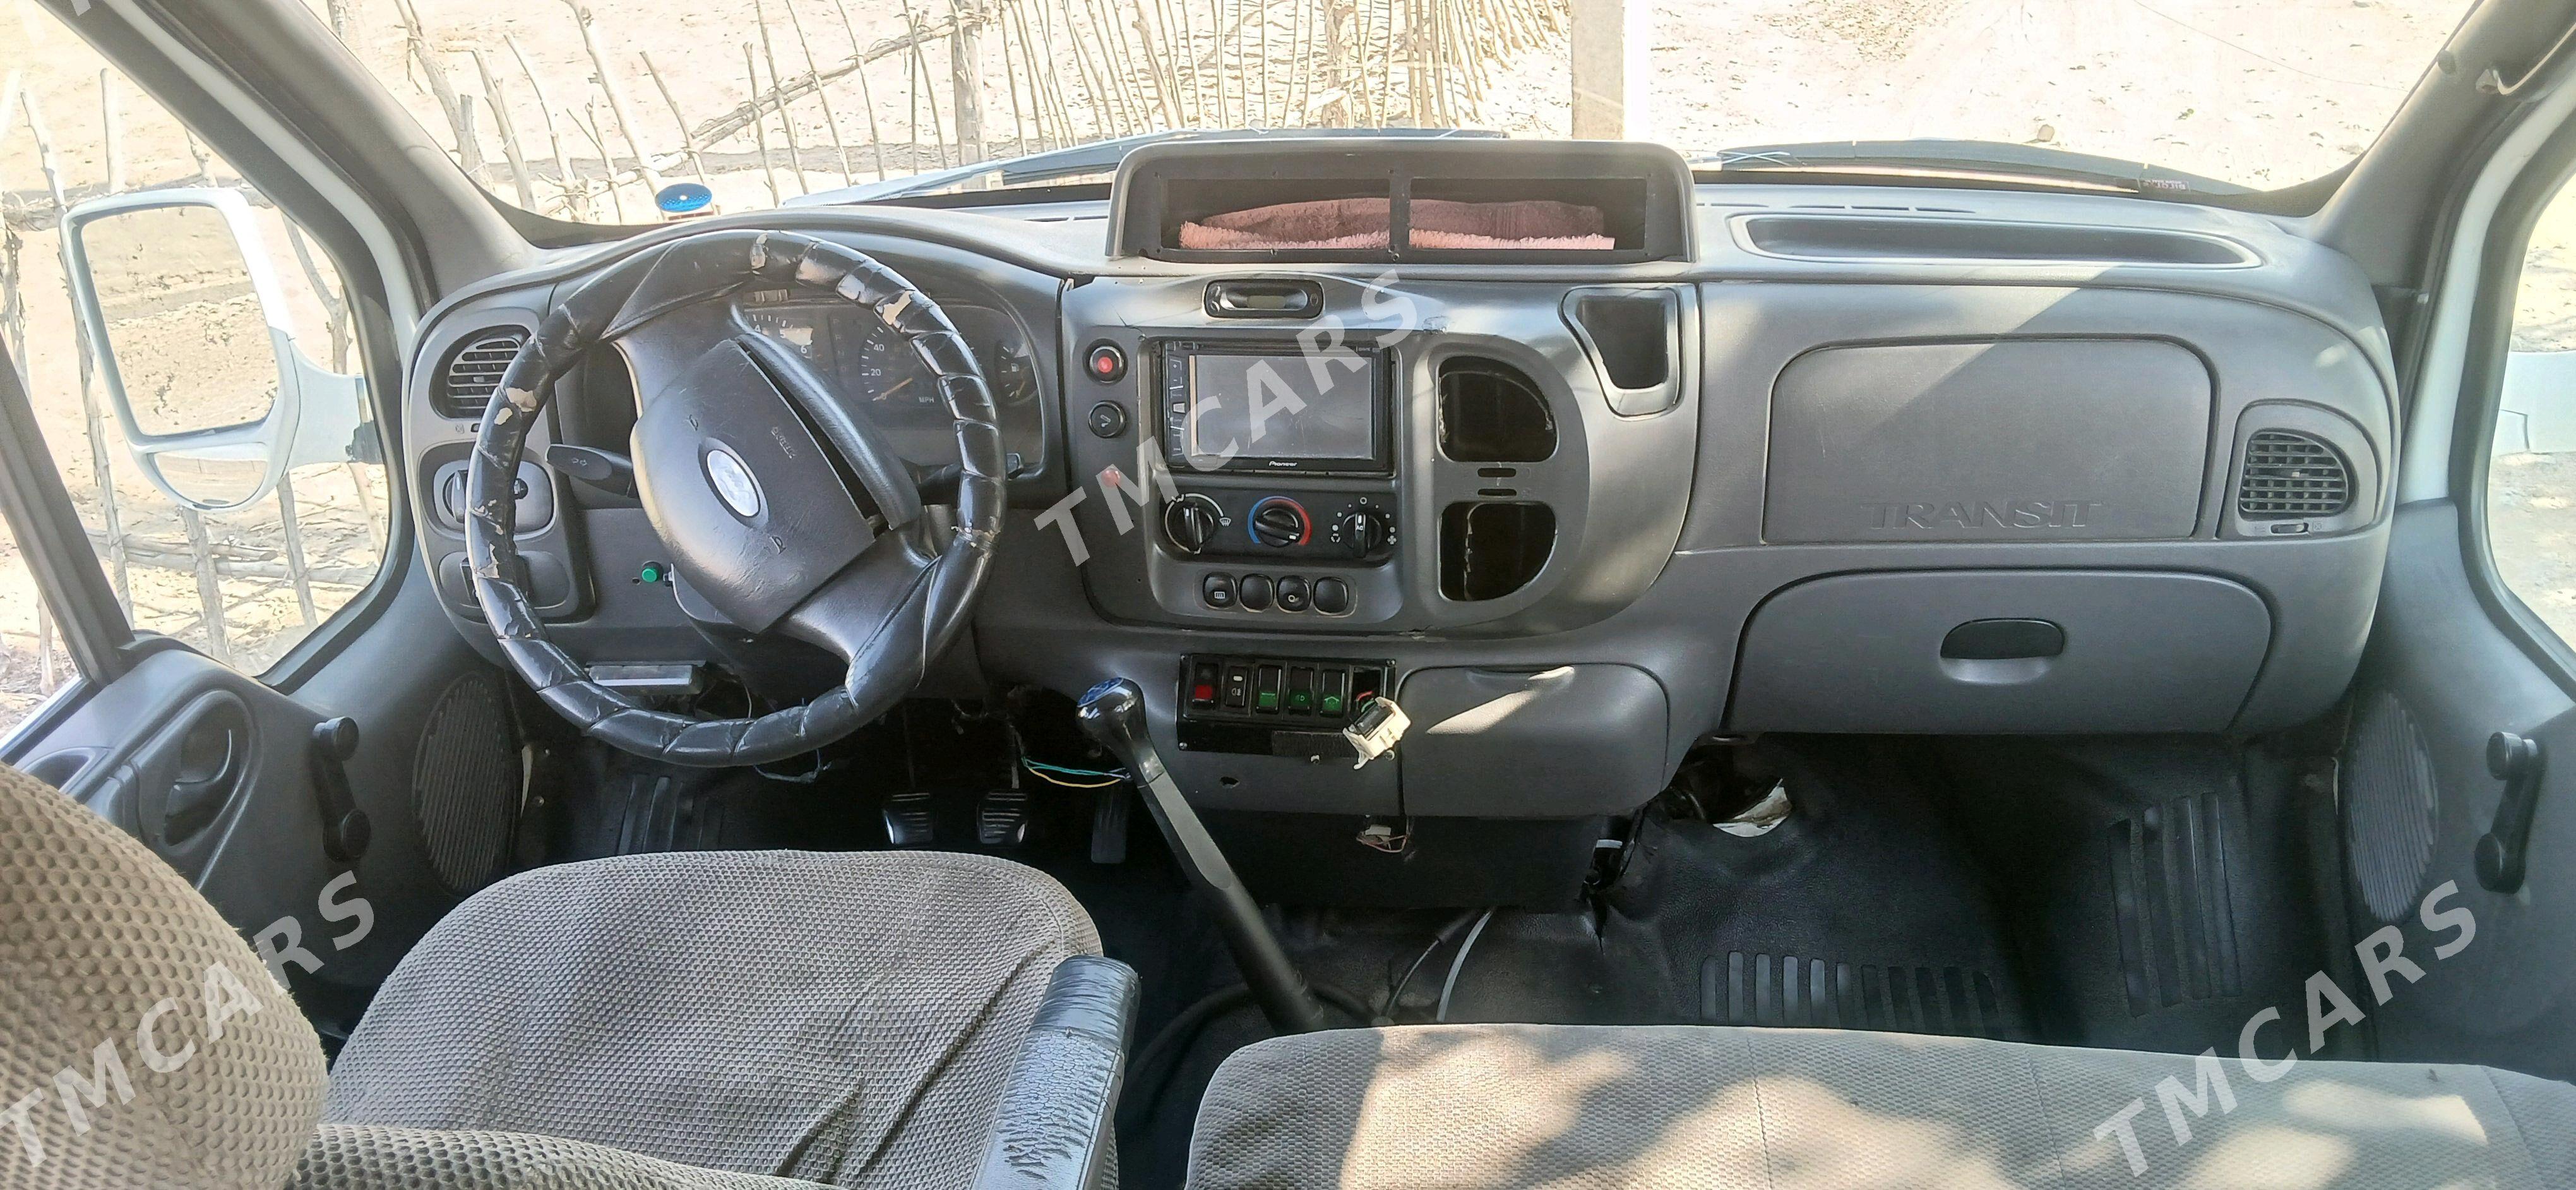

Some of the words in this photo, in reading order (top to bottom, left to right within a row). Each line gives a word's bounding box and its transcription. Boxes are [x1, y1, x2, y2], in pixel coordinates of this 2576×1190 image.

[754, 324, 761, 333] 4
[801, 345, 808, 354] 6
[874, 344, 885, 352] 40
[871, 368, 881, 376] 20
[1860, 500, 2104, 529] TRANSIT
